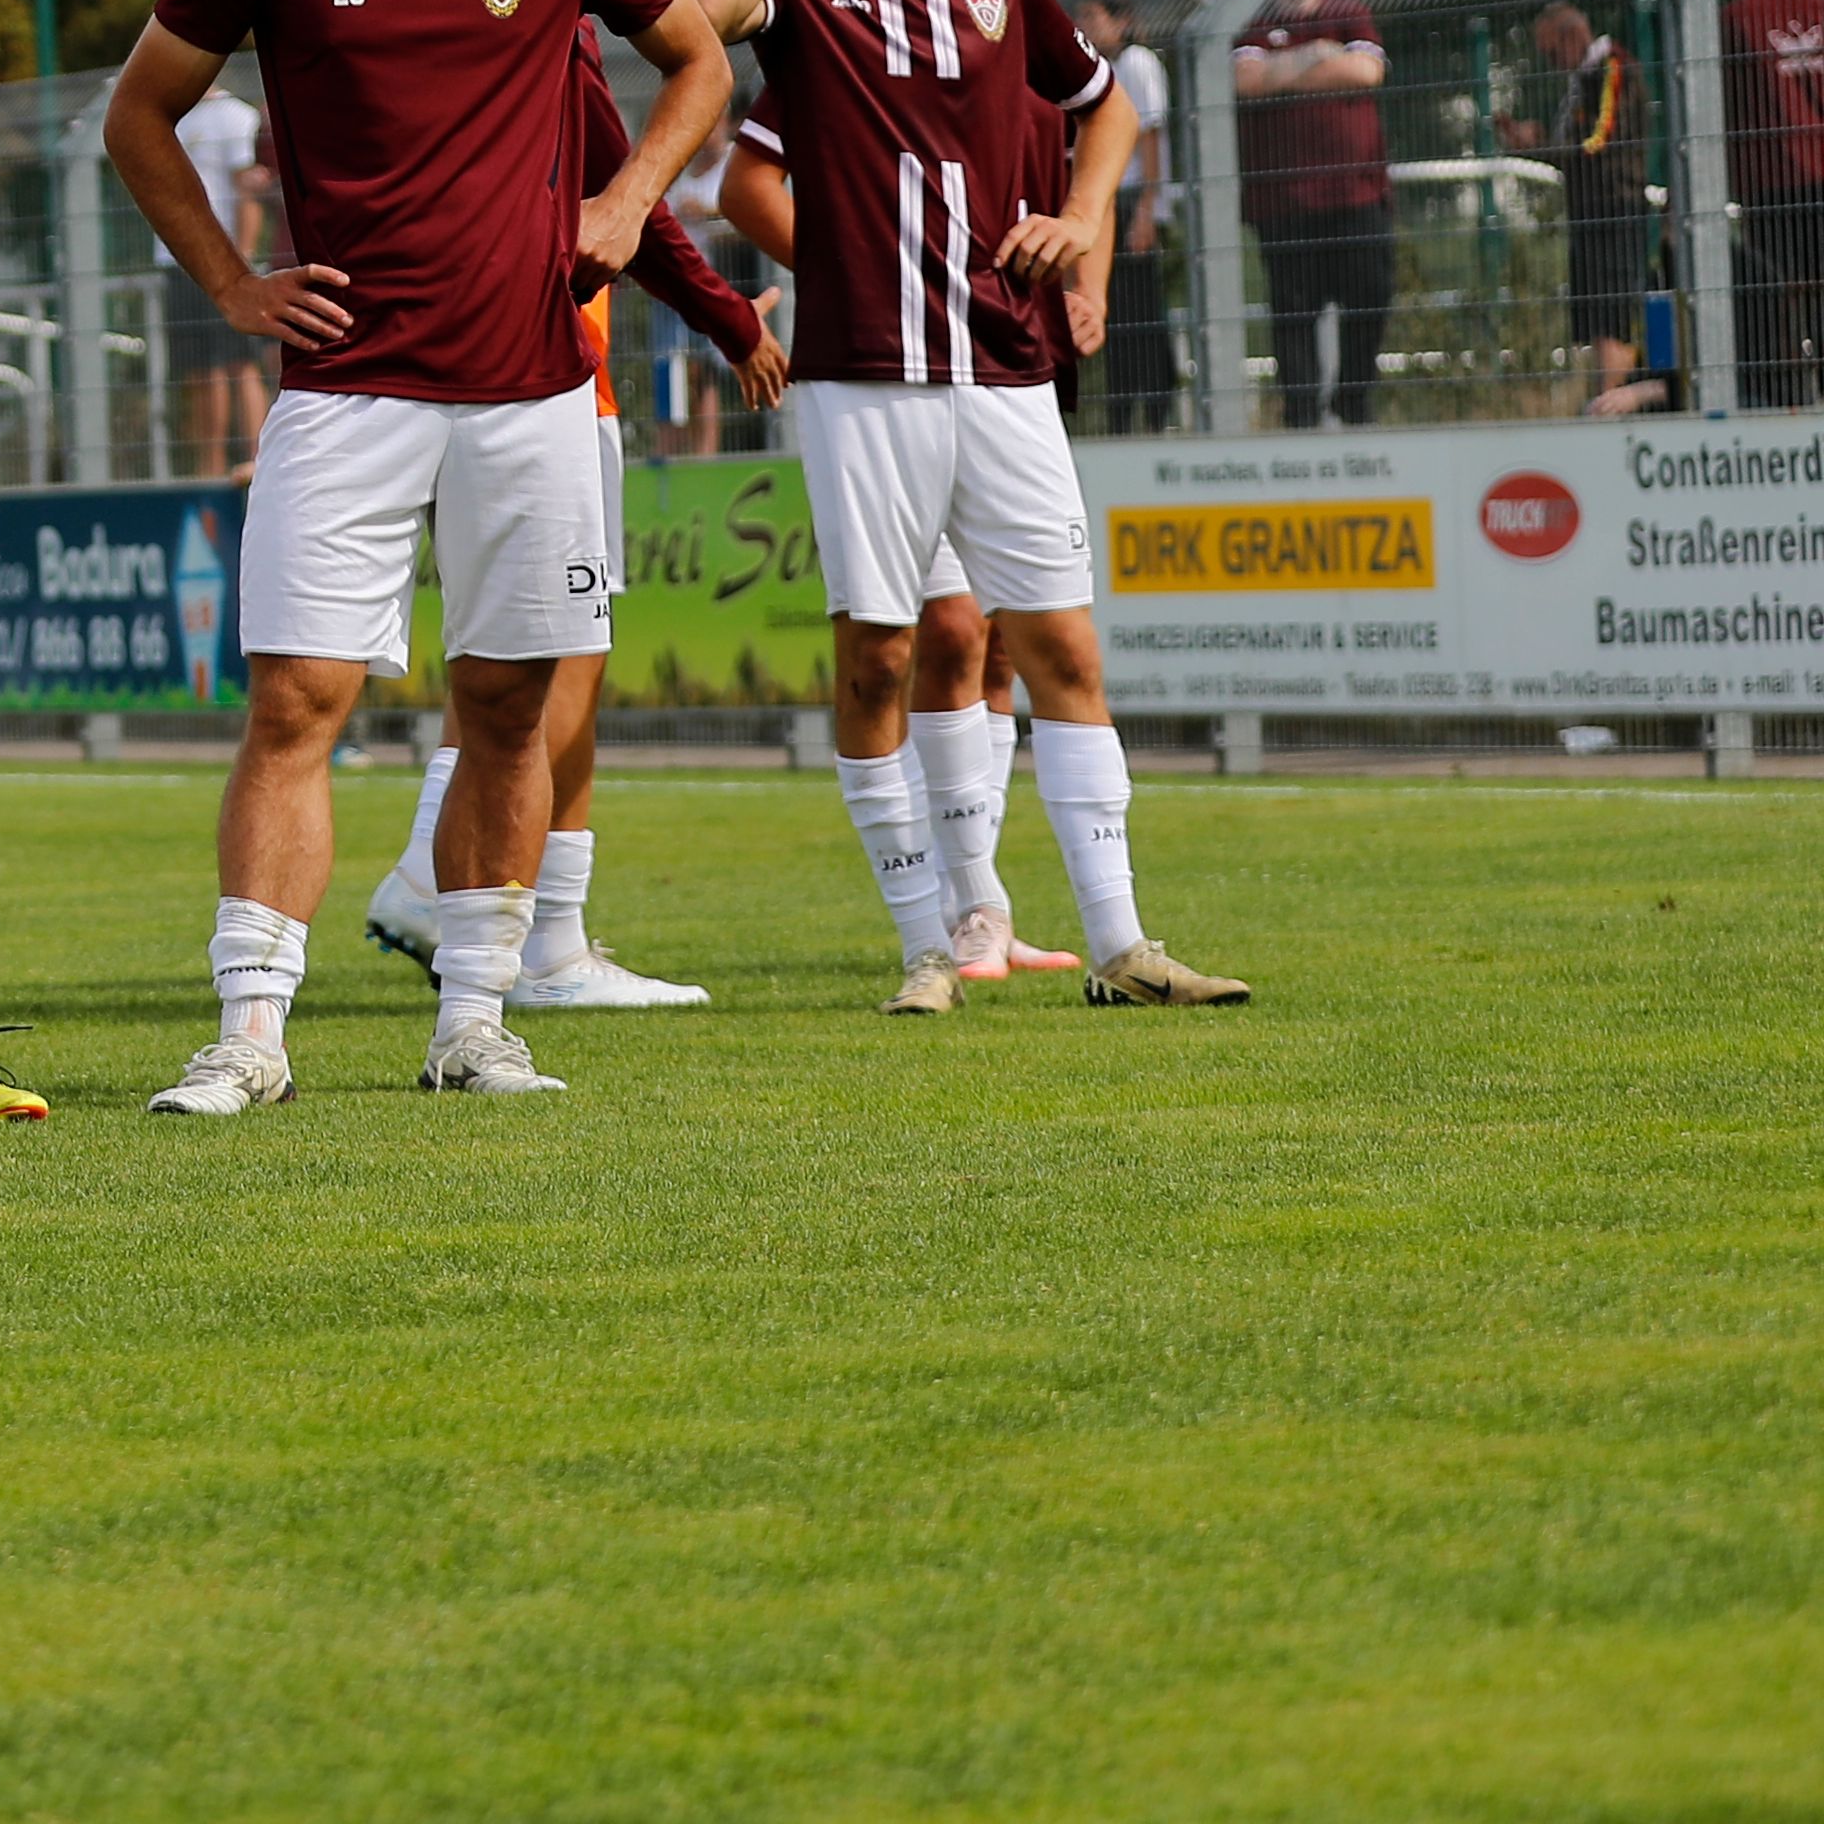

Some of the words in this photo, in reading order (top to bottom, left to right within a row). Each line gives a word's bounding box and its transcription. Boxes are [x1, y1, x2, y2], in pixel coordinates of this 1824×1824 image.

[1117, 520, 1206, 578] DIRK
[1219, 514, 1424, 575] GRANITZA
[1354, 620, 1439, 650] SERVICE
[942, 801, 986, 821] JAKO
[1093, 825, 1125, 843] JAK
[881, 850, 926, 872] JAKO
